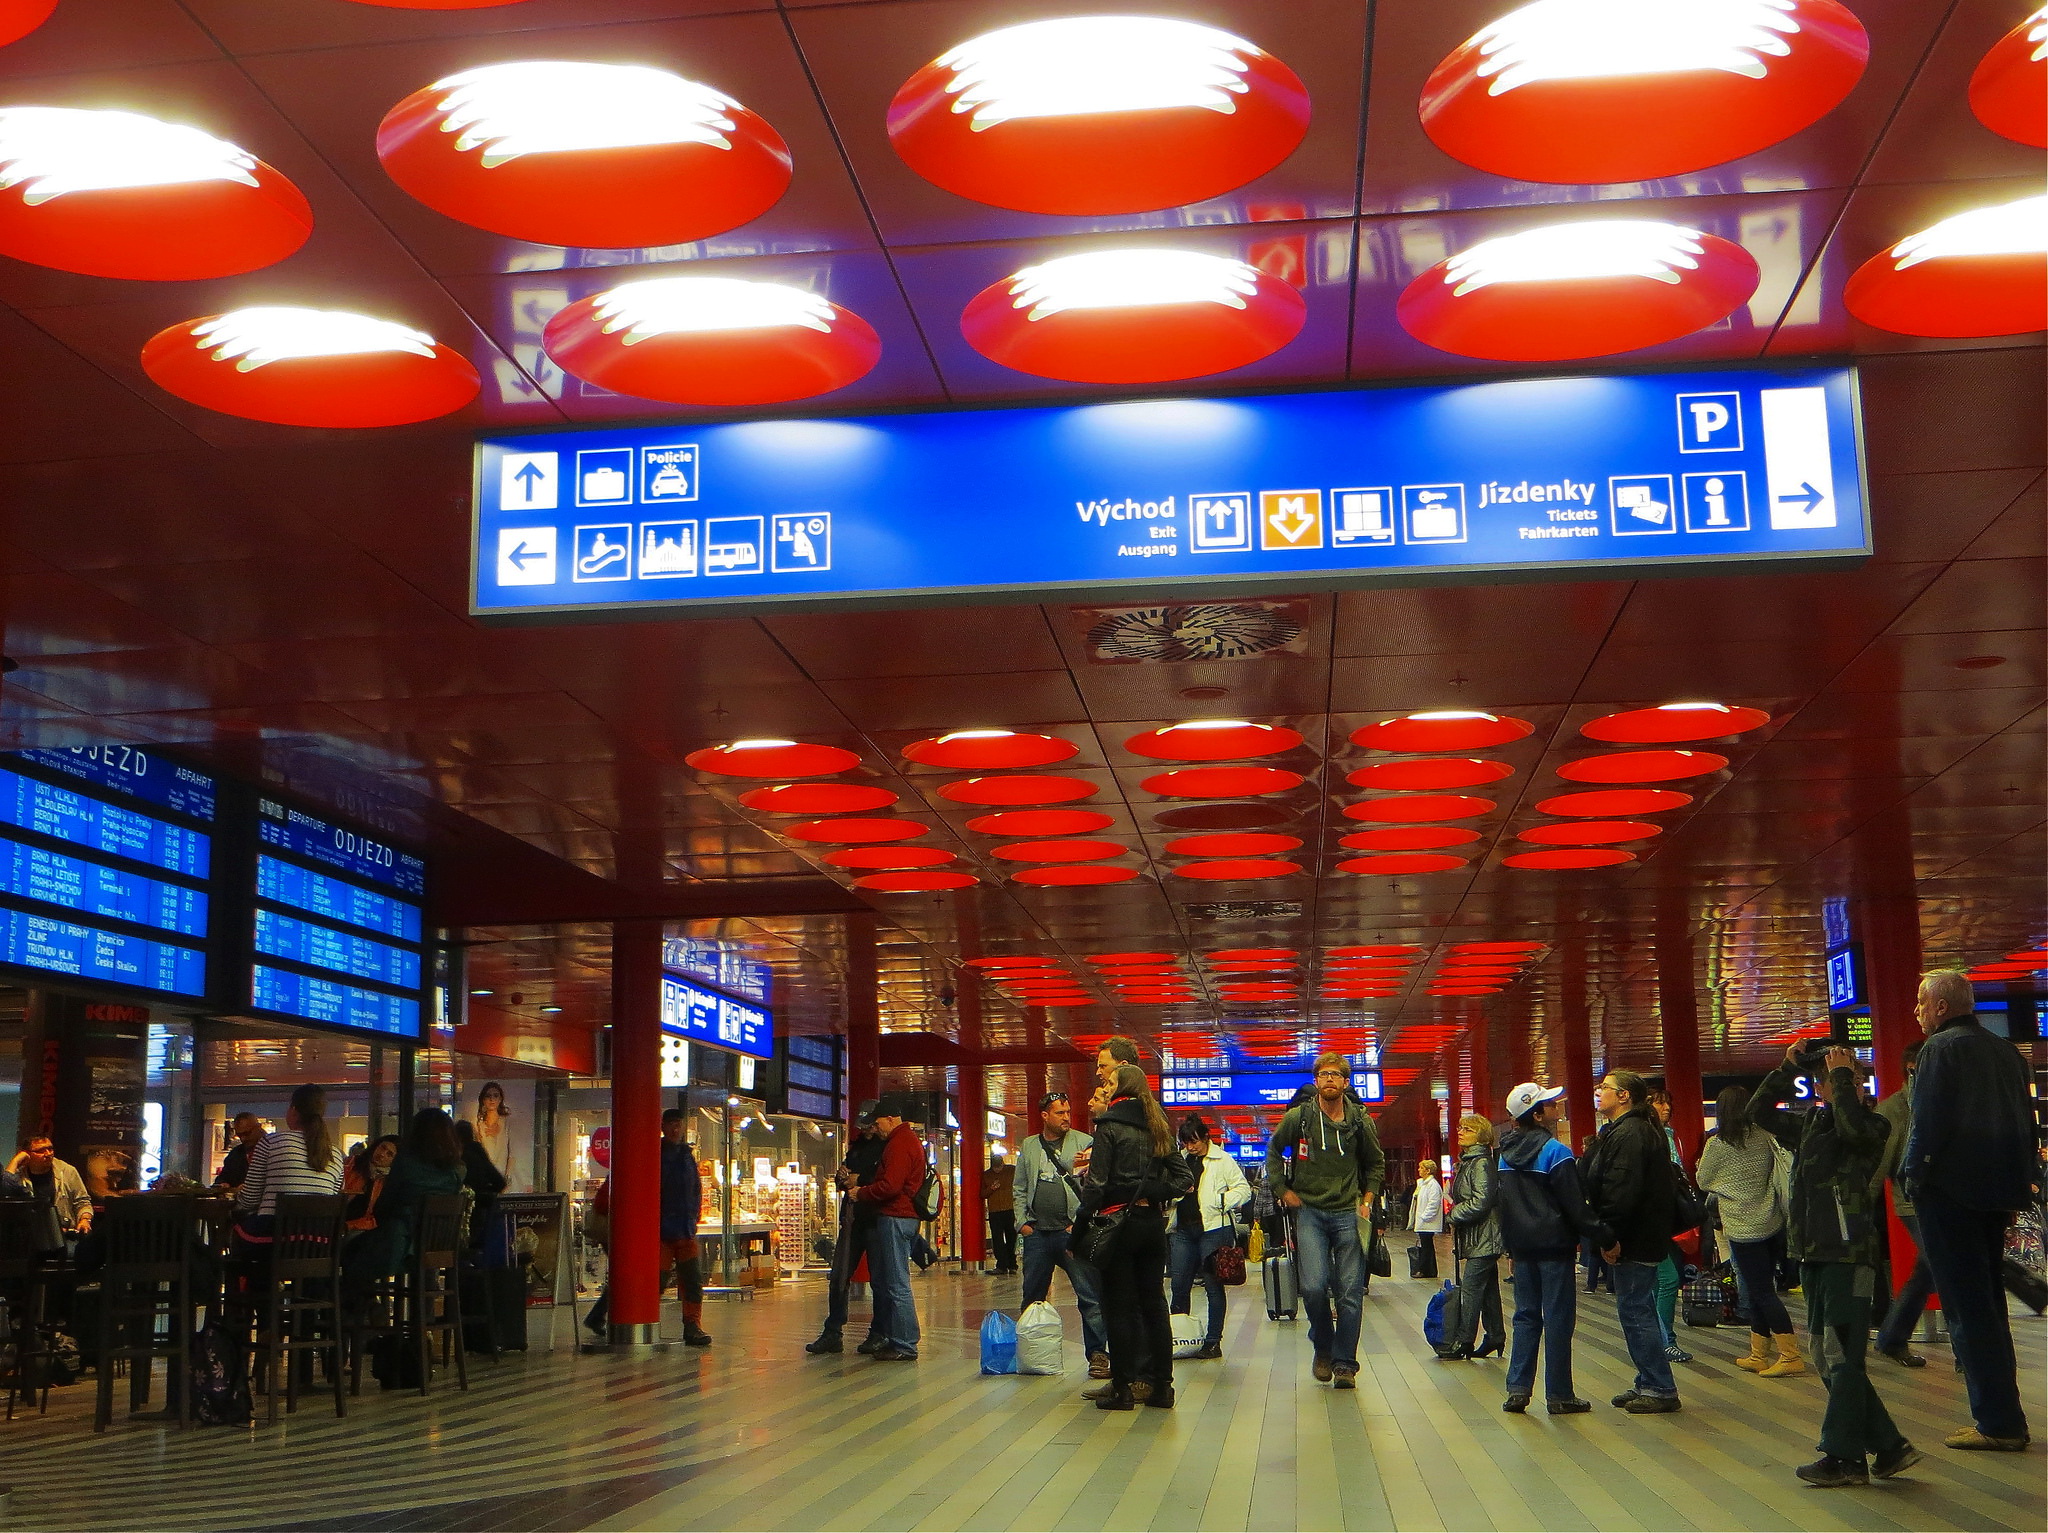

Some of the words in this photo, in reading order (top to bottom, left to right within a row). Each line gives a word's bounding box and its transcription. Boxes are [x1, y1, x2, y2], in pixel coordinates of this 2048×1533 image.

[1690, 403, 1728, 442] P
[648, 450, 692, 464] Policie
[1478, 479, 1596, 509] Jízdenky
[1076, 496, 1175, 526] Východ
[1546, 509, 1598, 522] Tickets
[778, 521, 794, 542] 1
[1149, 526, 1177, 538] Exit
[1519, 526, 1598, 540] Fahrkarten
[1118, 544, 1177, 558] Ausgang
[176, 767, 213, 789] ABFAHRT
[34, 808, 60, 824] BEROUN
[288, 810, 326, 833] DEPARTURE
[34, 820, 52, 834] BRNO
[32, 850, 50, 865] BRNO
[335, 828, 393, 868] ODJEZD
[30, 862, 53, 877] PRAHA
[55, 868, 80, 885] LETIŠTĚ
[100, 880, 124, 896] Terminál
[30, 875, 82, 896] PRAHA-SMÍCHOV
[28, 916, 58, 933] BENEŠOV
[60, 924, 66, 934] U
[68, 926, 90, 940] PRAHY
[25, 954, 81, 975] PRAHA-VRŠOVICE
[116, 960, 138, 973] Skalice
